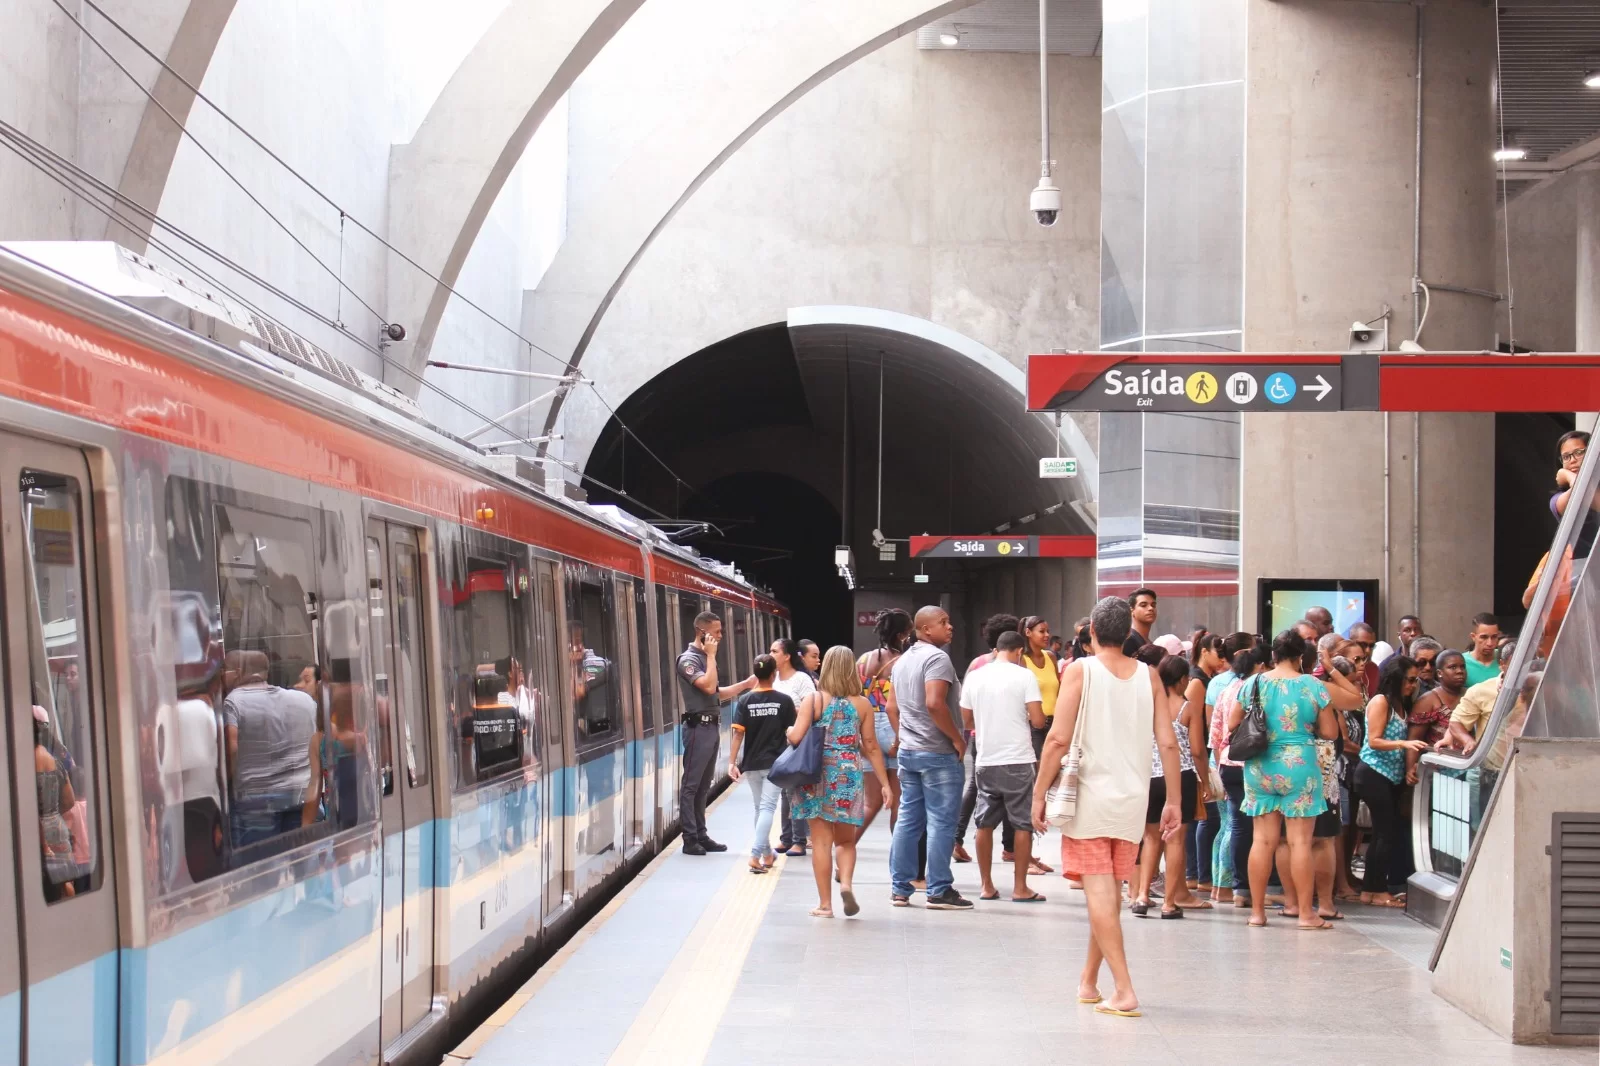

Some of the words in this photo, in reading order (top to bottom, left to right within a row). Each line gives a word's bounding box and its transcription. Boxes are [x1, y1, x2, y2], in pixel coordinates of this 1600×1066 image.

[1104, 368, 1185, 395] Saída
[1136, 397, 1154, 407] Exit
[953, 541, 985, 552] Saída
